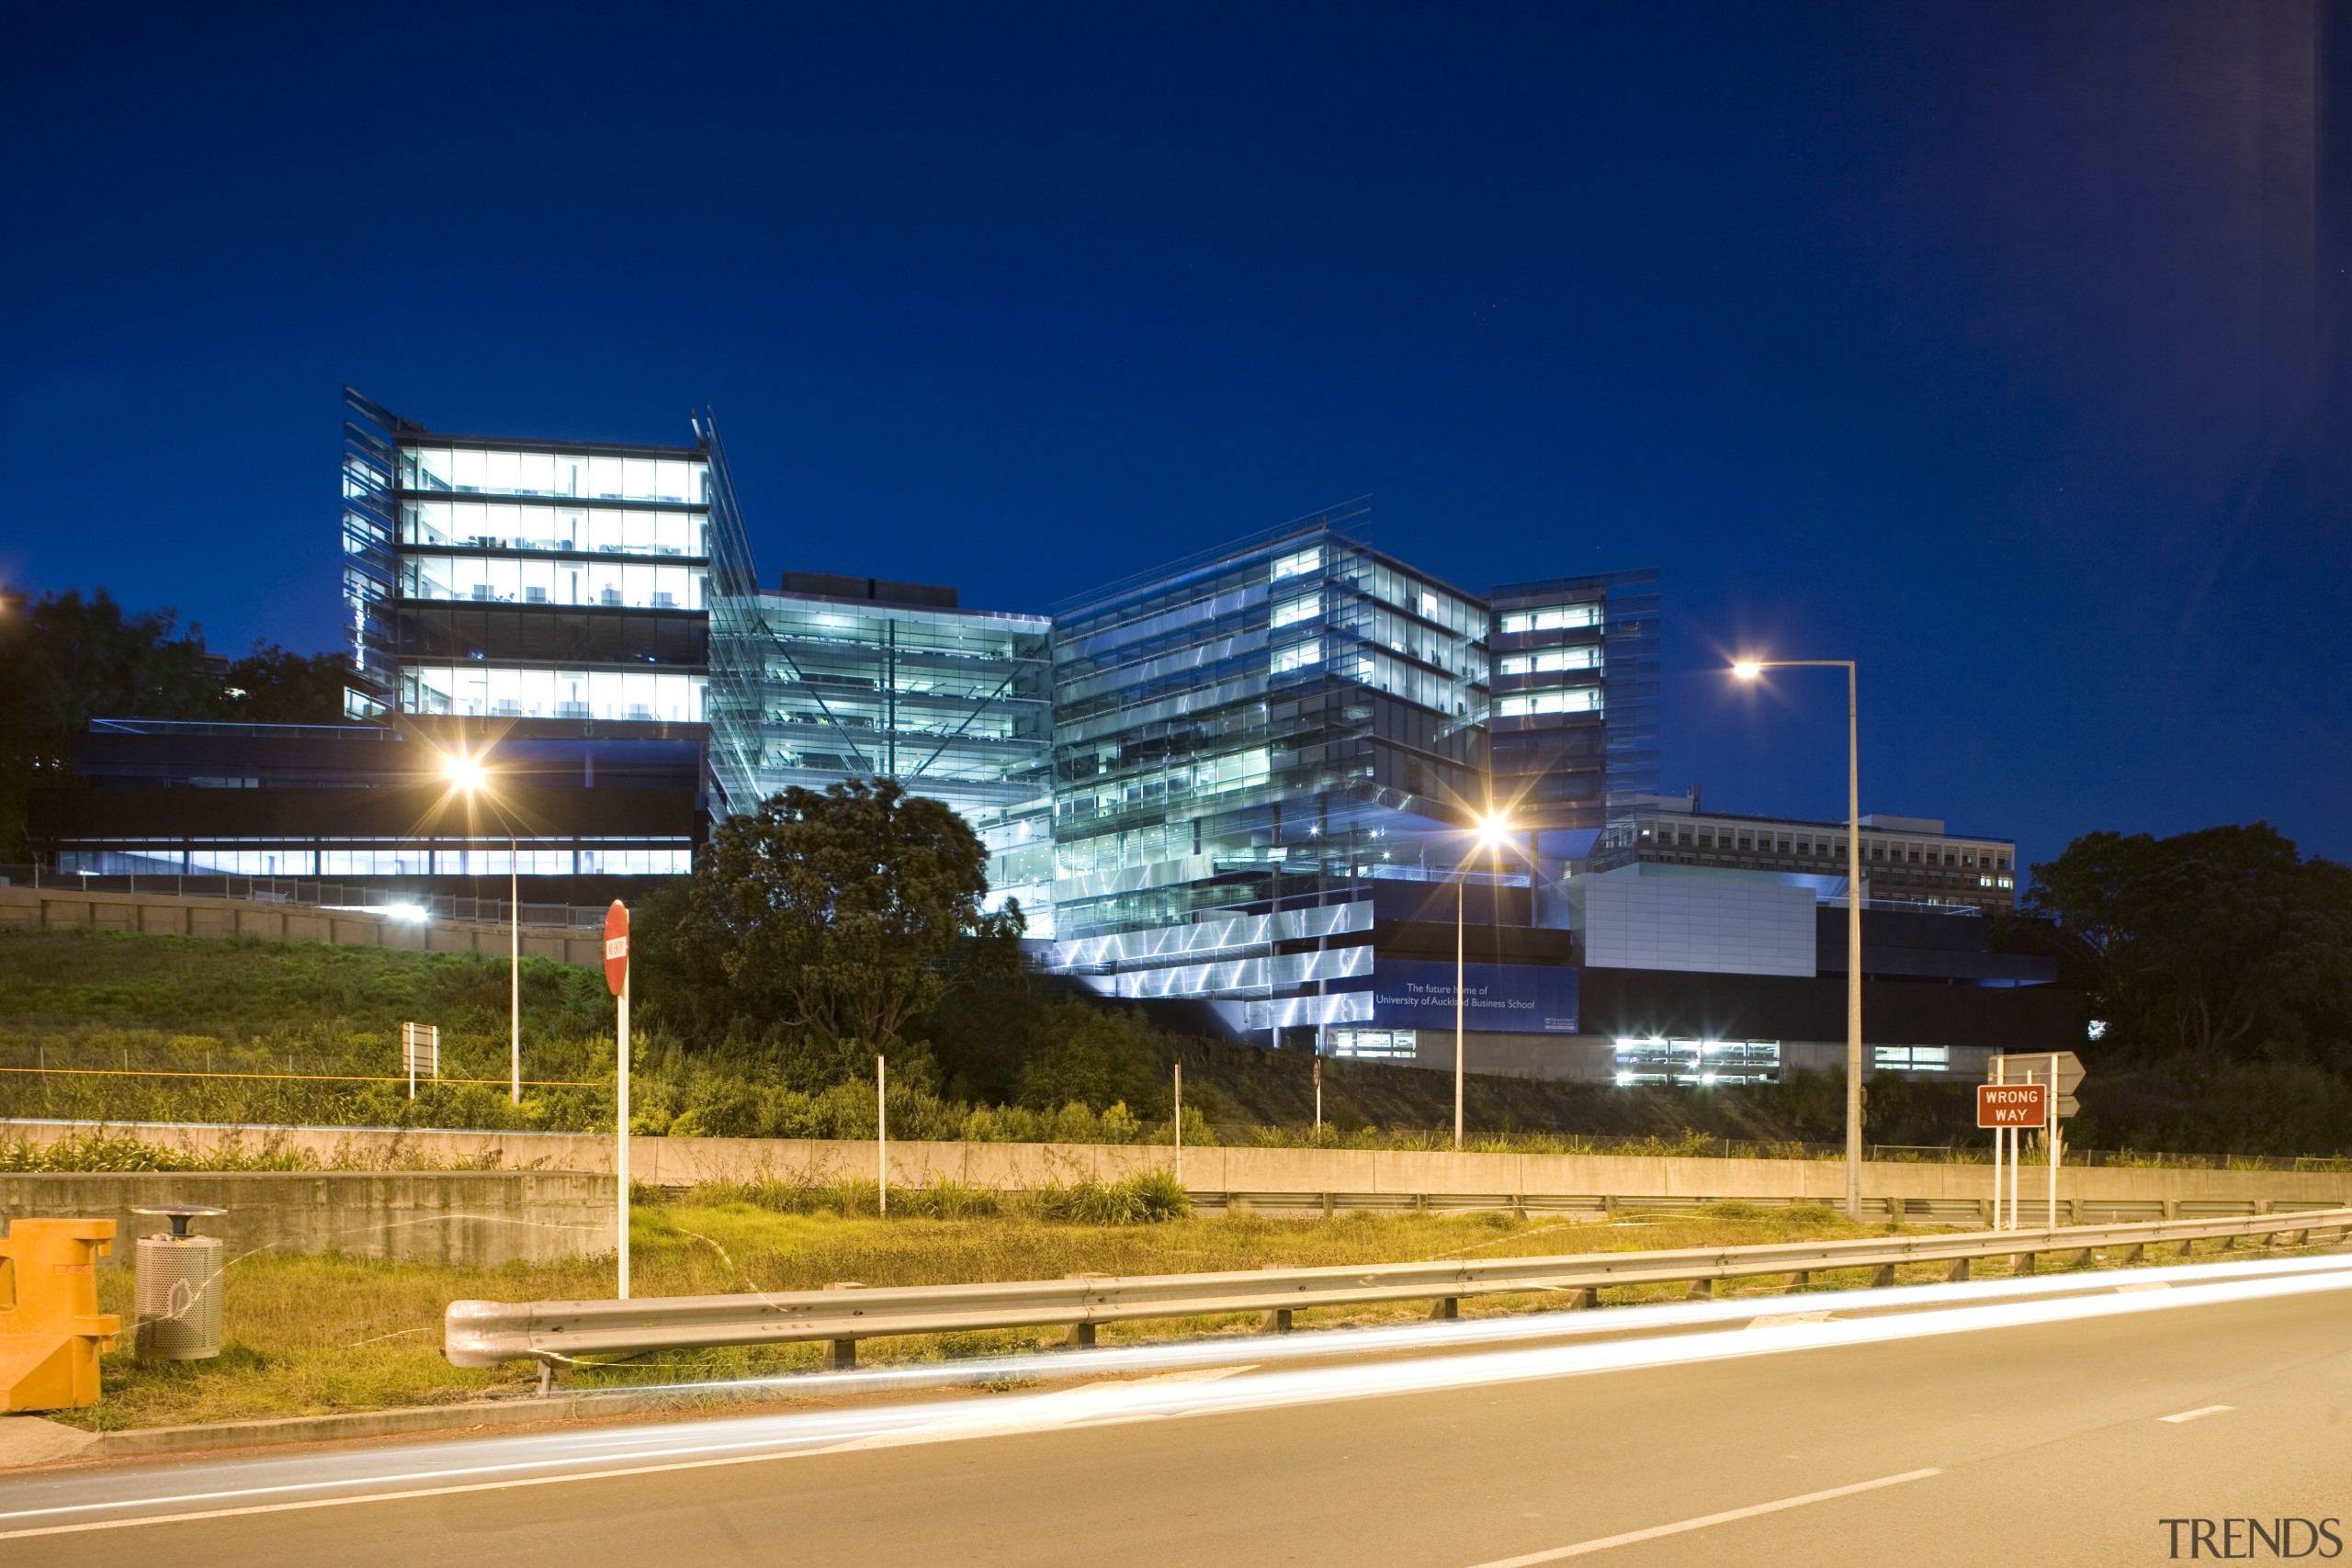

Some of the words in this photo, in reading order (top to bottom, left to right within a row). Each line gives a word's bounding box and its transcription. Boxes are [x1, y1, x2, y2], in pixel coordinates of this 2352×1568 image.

[1407, 983, 1423, 992] The
[1426, 984, 1451, 994] future
[1479, 986, 1488, 995] of
[1376, 995, 1419, 1007] University
[1421, 997, 1430, 1005] of
[1472, 998, 1506, 1008] Business
[1508, 999, 1535, 1009] School
[1985, 1090, 2039, 1103] WRONG
[1996, 1109, 2028, 1122] WAY
